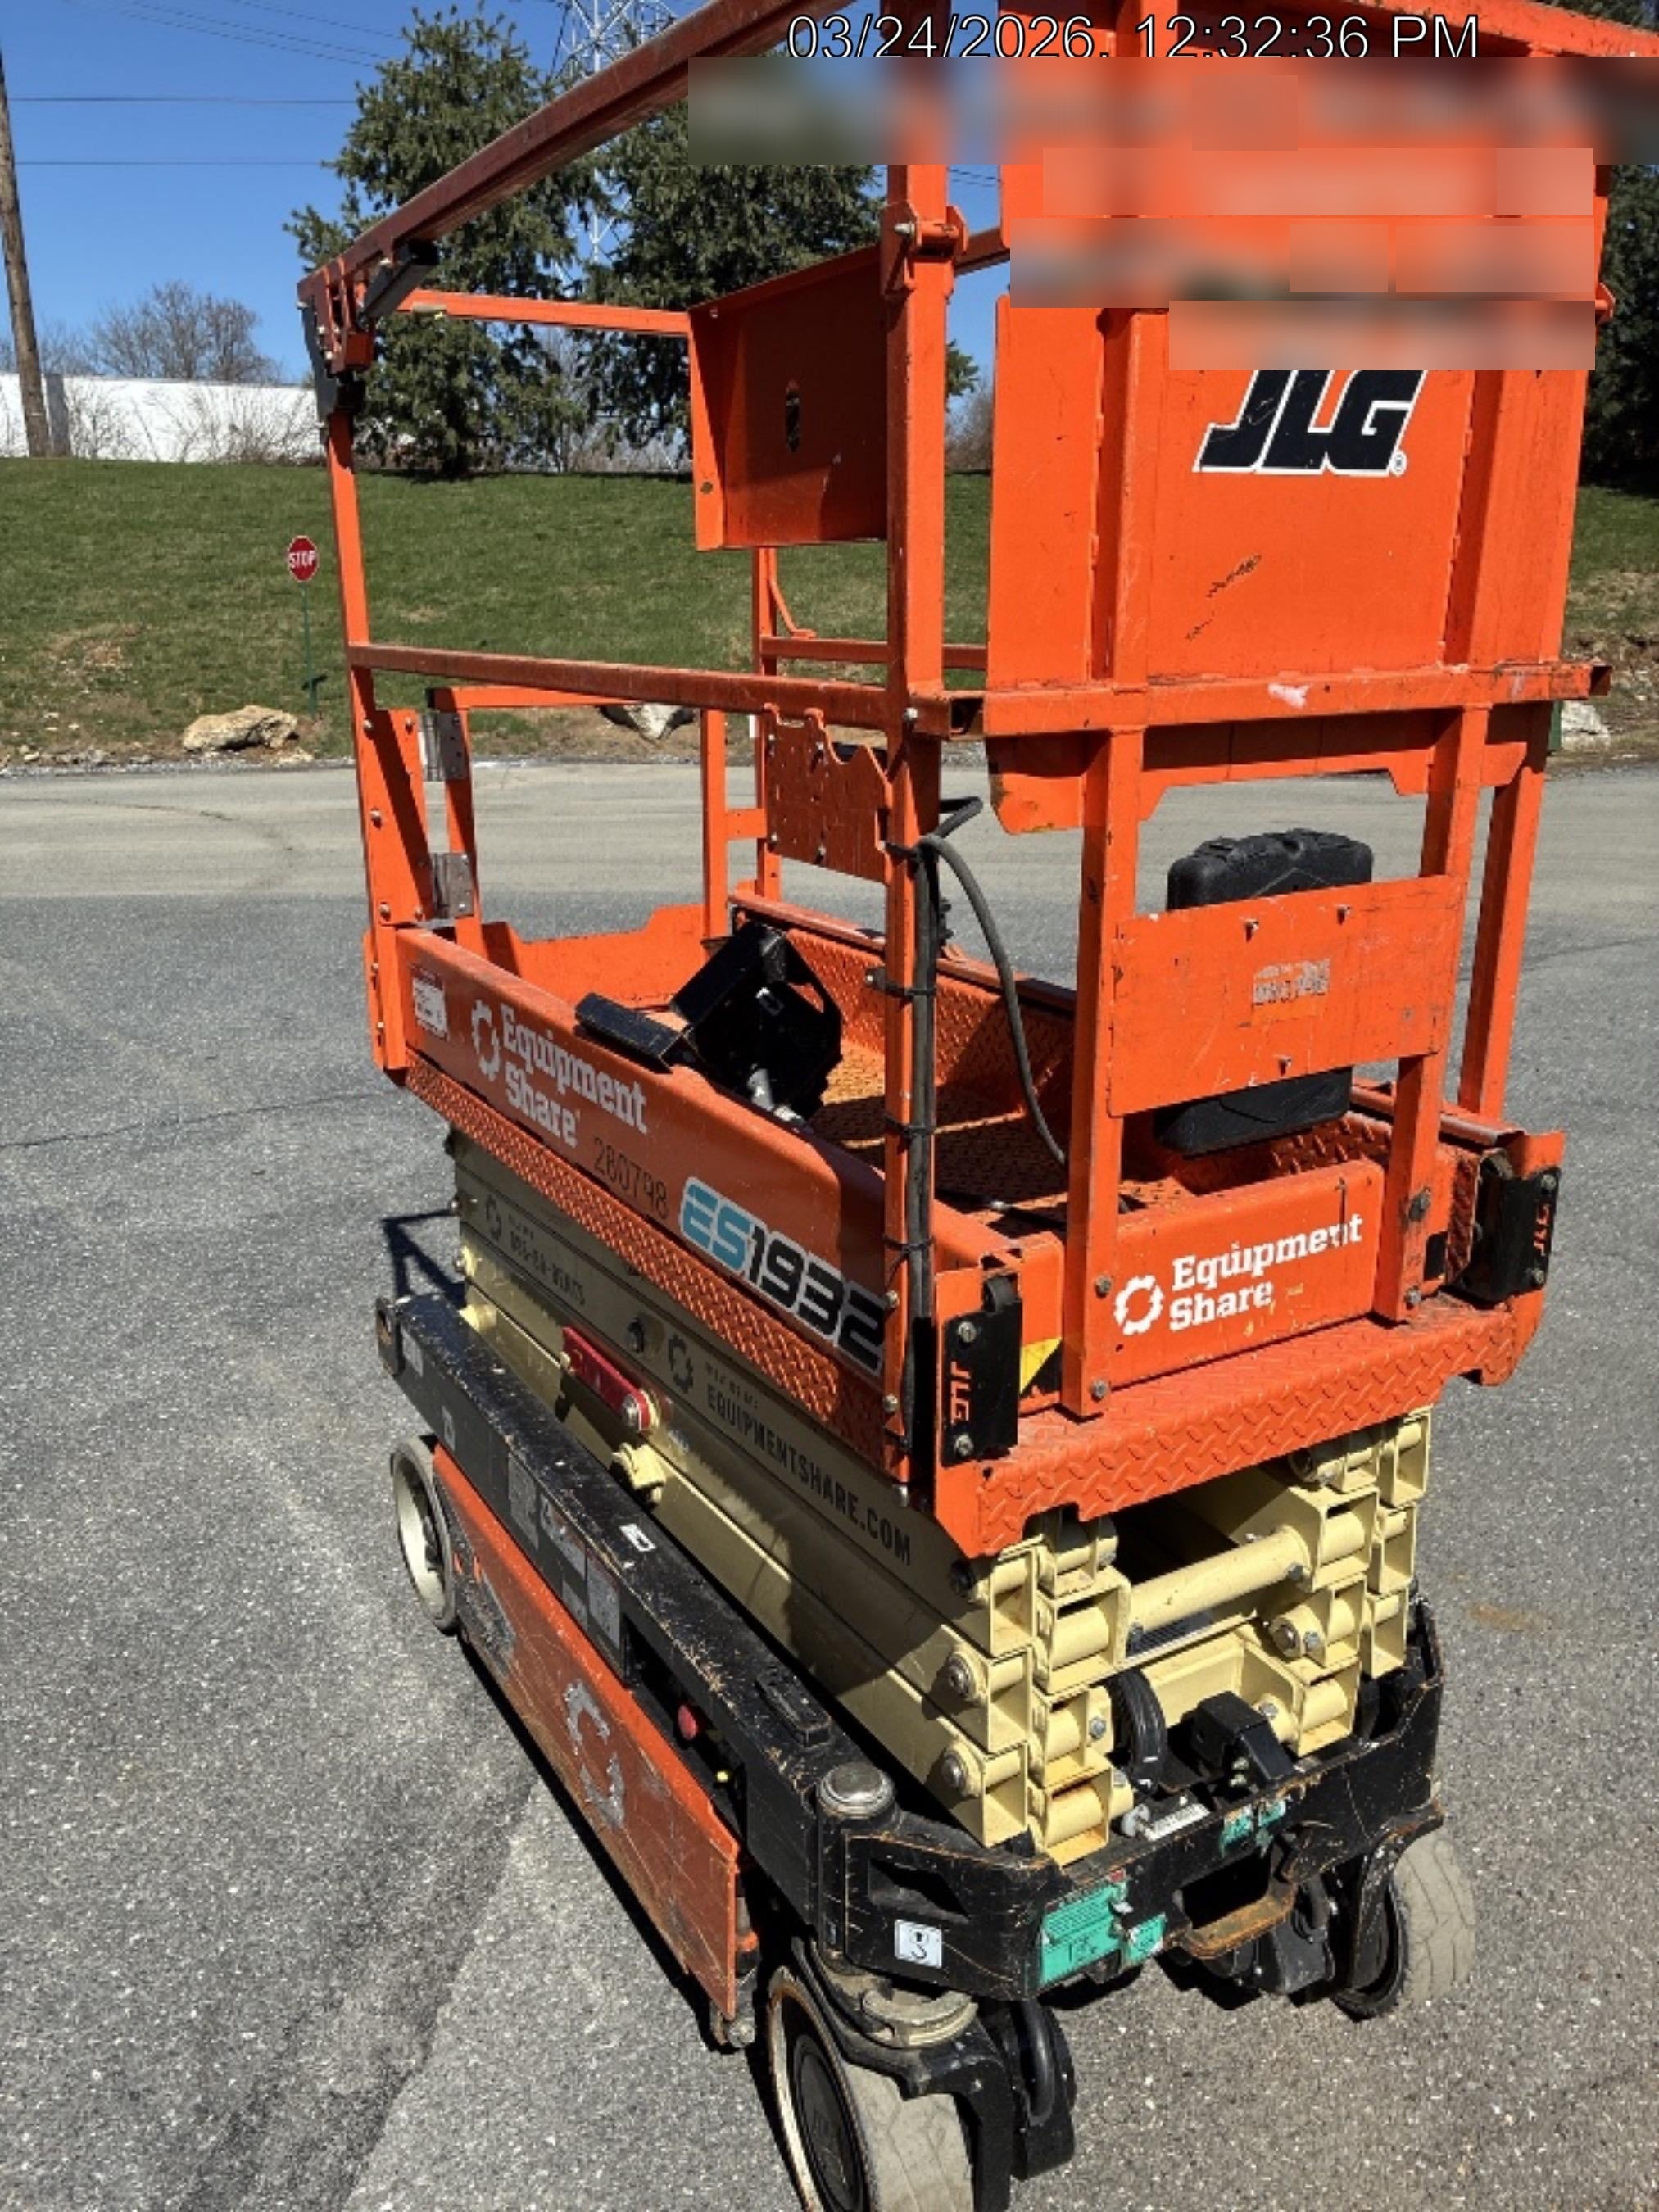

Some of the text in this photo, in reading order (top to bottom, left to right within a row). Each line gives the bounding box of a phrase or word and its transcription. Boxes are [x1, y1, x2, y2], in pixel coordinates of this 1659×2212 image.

[289, 550, 315, 569] STOP
[501, 1004, 647, 1135] Equipment
[505, 1061, 578, 1148] Share
[681, 1178, 885, 1376] ES1932
[1172, 1213, 1363, 1291] Equipment
[1169, 1281, 1274, 1332] Share
[950, 1361, 971, 1425] JLG
[707, 1383, 911, 1566] EQUIPMENTSHARE.COM
